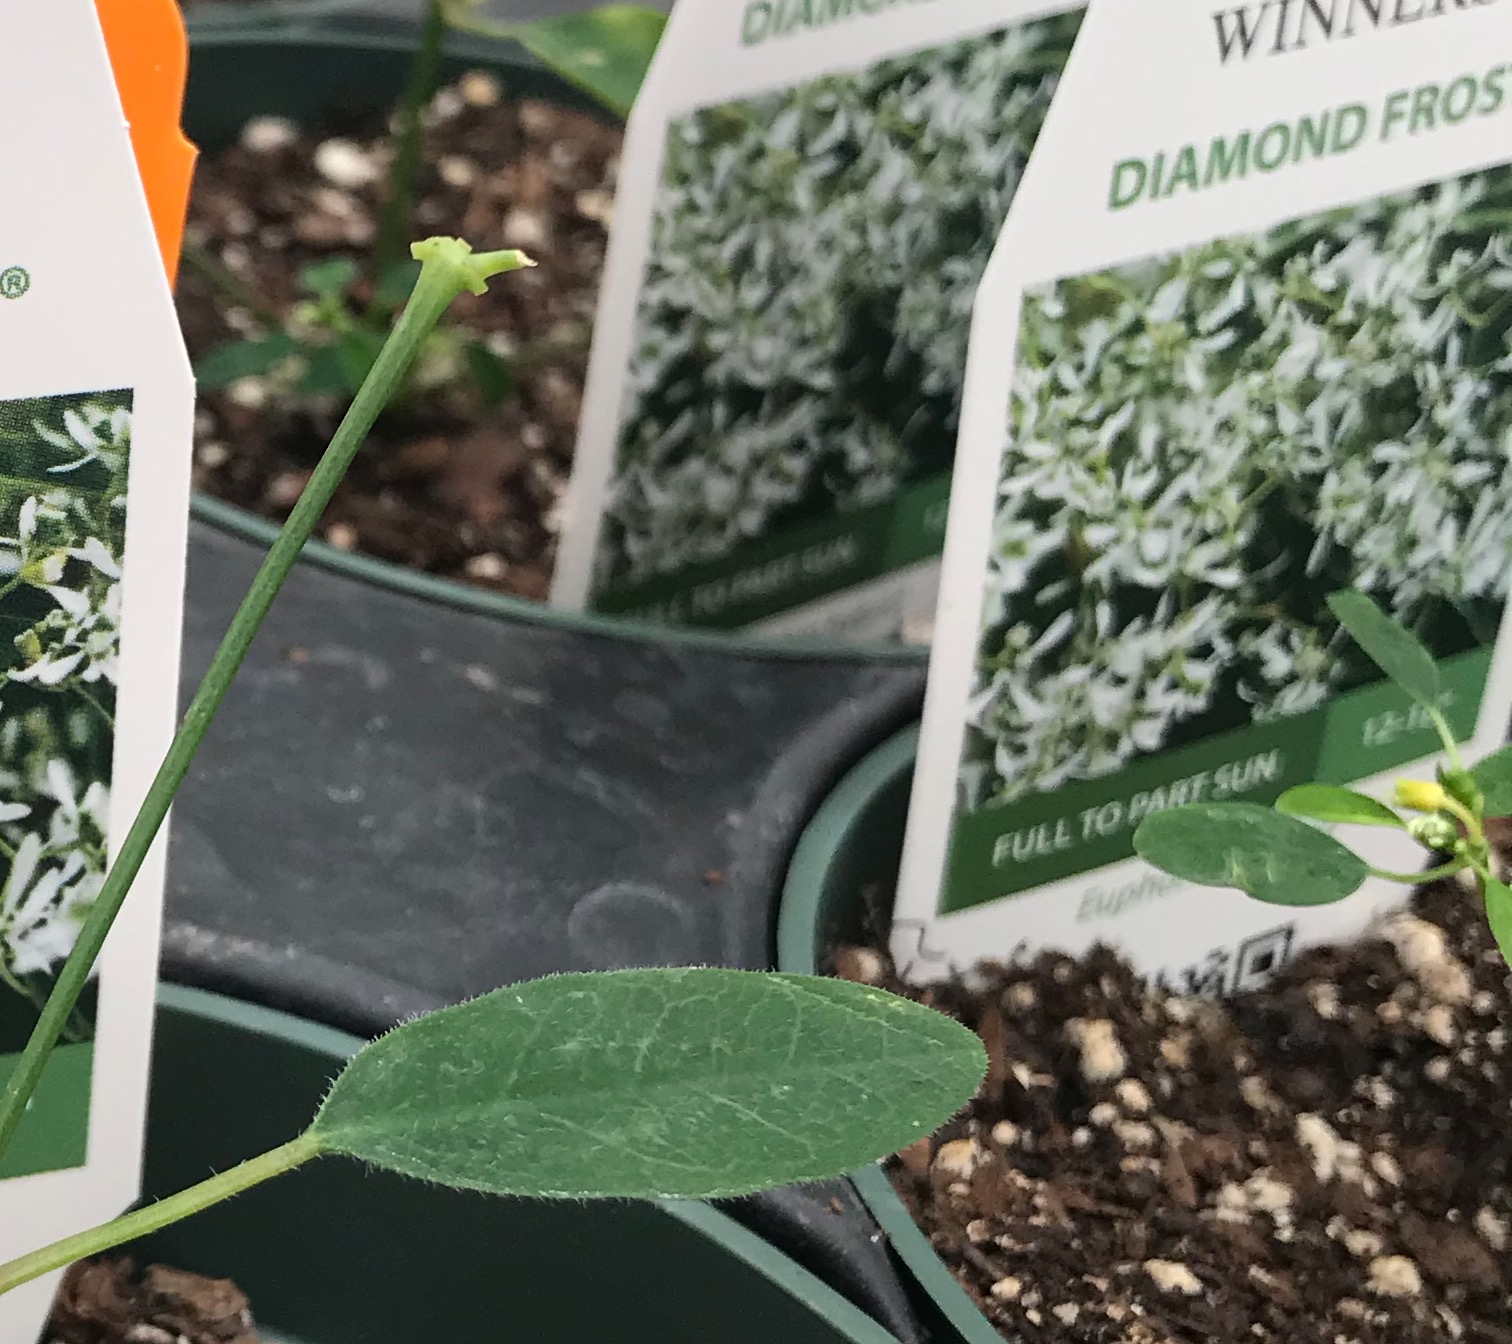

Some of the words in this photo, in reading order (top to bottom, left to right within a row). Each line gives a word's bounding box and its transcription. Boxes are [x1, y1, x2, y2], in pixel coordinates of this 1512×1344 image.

[1107, 101, 1370, 212] DIAMOND
[1379, 62, 1512, 142] FROS
[992, 819, 1073, 866] FULL
[1081, 800, 1125, 841] TO
[1212, 746, 1284, 800] SUN
